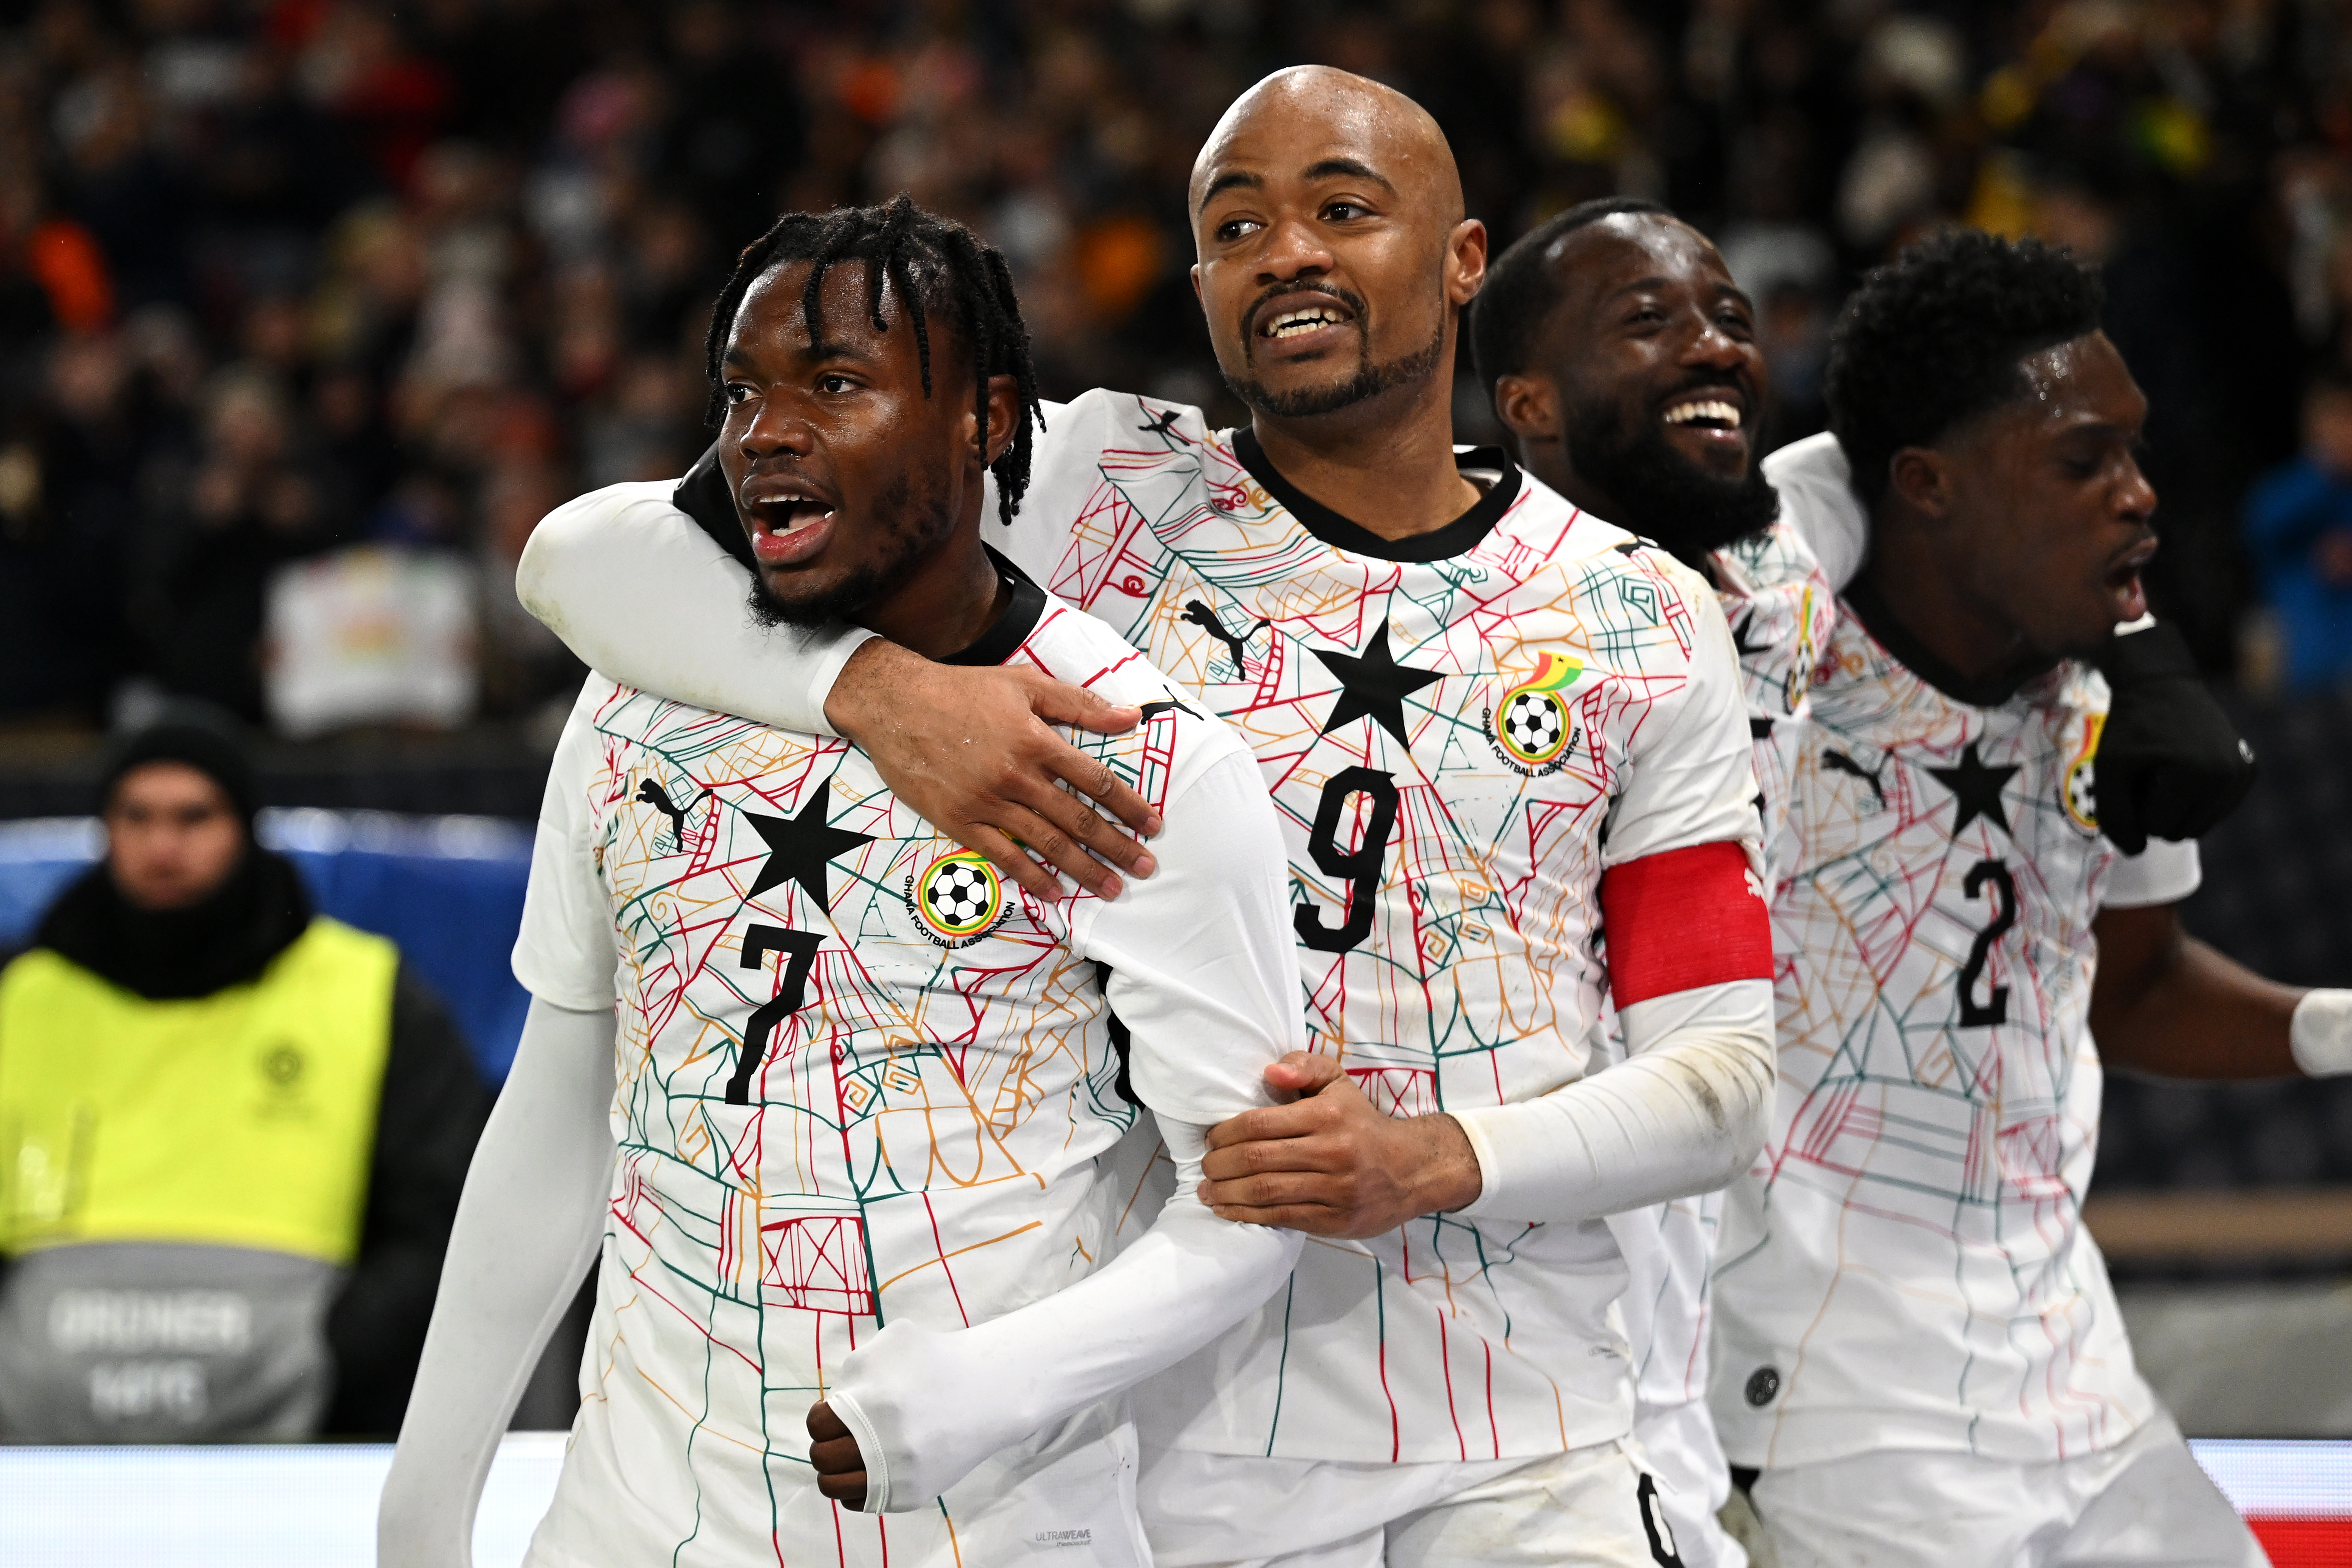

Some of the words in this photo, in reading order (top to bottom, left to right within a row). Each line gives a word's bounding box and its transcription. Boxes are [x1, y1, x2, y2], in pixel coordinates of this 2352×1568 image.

[1482, 707, 1495, 745] GHANA
[1491, 744, 1536, 778] FOOTBALL
[1538, 727, 1581, 777] ASSOCIATION
[904, 875, 915, 915] GHANA
[911, 915, 959, 949] FOOTBALL
[961, 901, 1016, 948] ASSOCIATION
[1293, 766, 1397, 953] 9
[1958, 858, 2016, 1027] 2
[725, 924, 828, 1105] 7
[1035, 1528, 1091, 1541] ULTRAWEAVE
